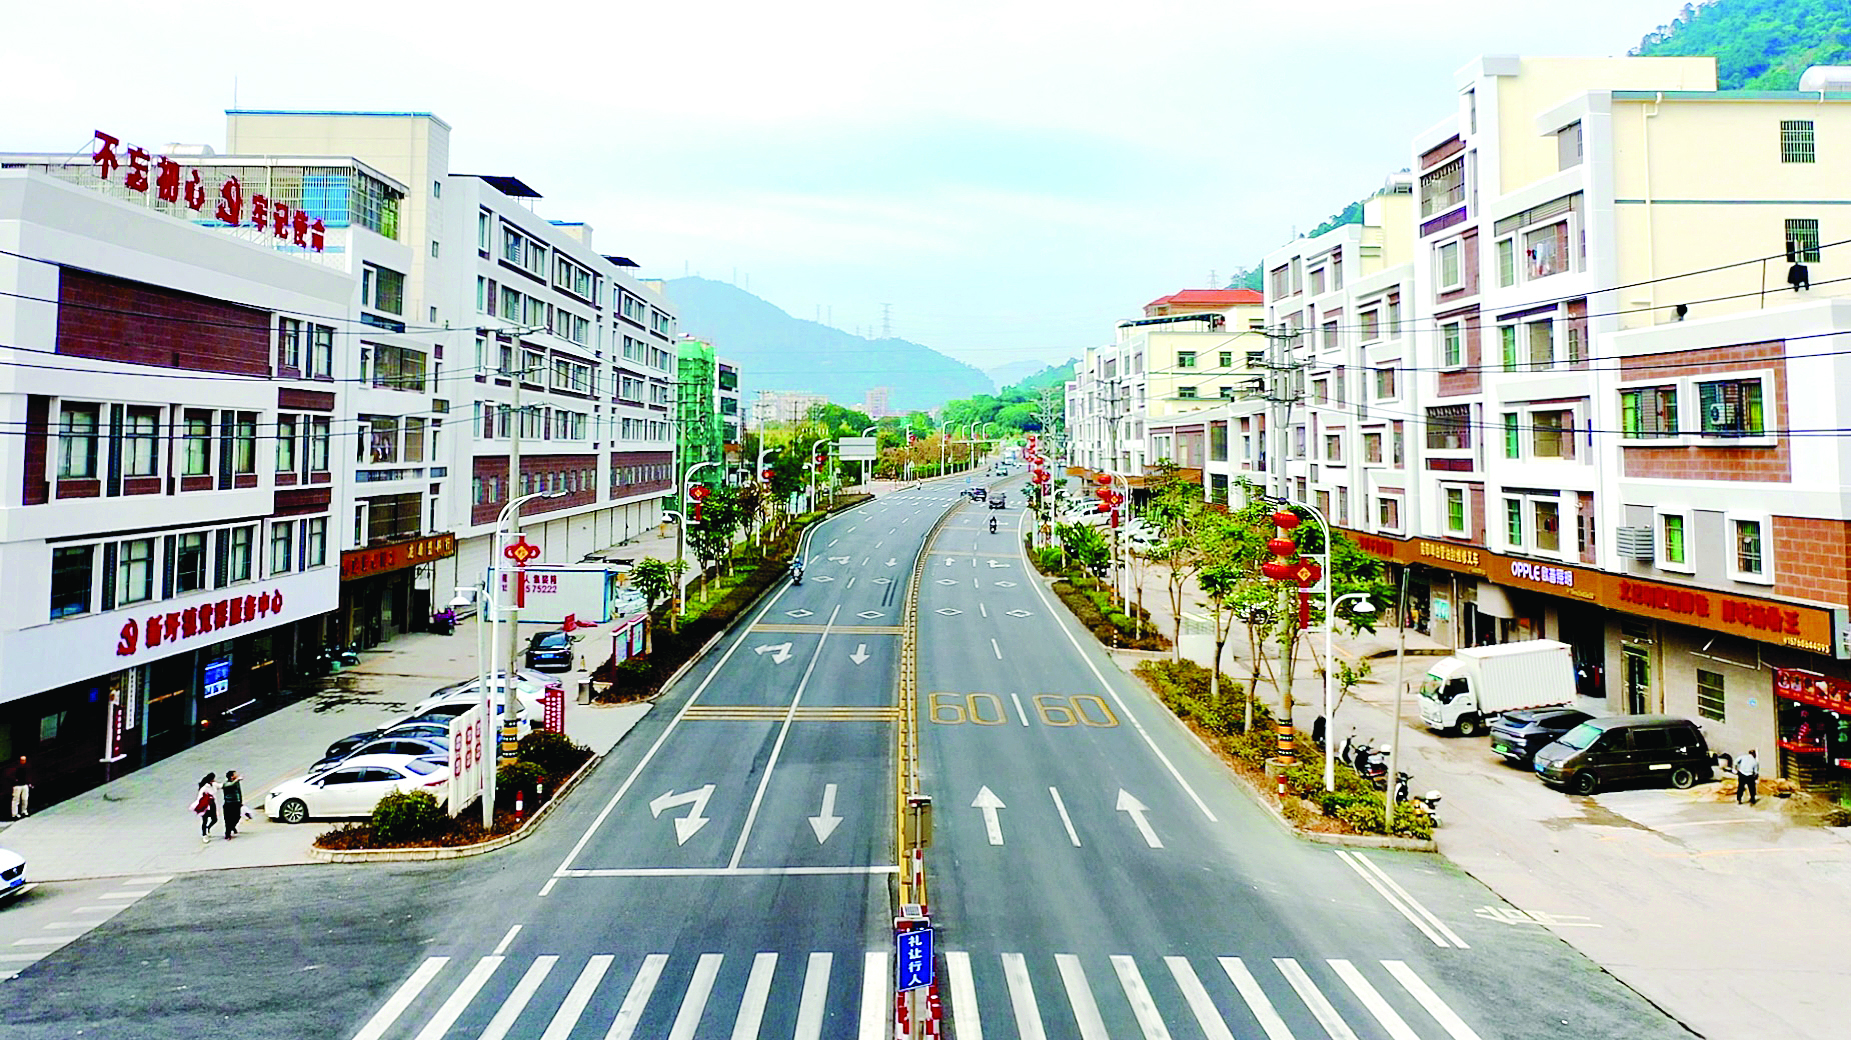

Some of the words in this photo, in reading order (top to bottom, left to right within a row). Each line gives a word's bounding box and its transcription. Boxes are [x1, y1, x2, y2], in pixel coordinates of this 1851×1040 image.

[1511, 561, 1541, 582] OPPLE
[928, 692, 1007, 726] 60
[1032, 693, 1118, 728] 60
[907, 934, 923, 987] 礼让行人
